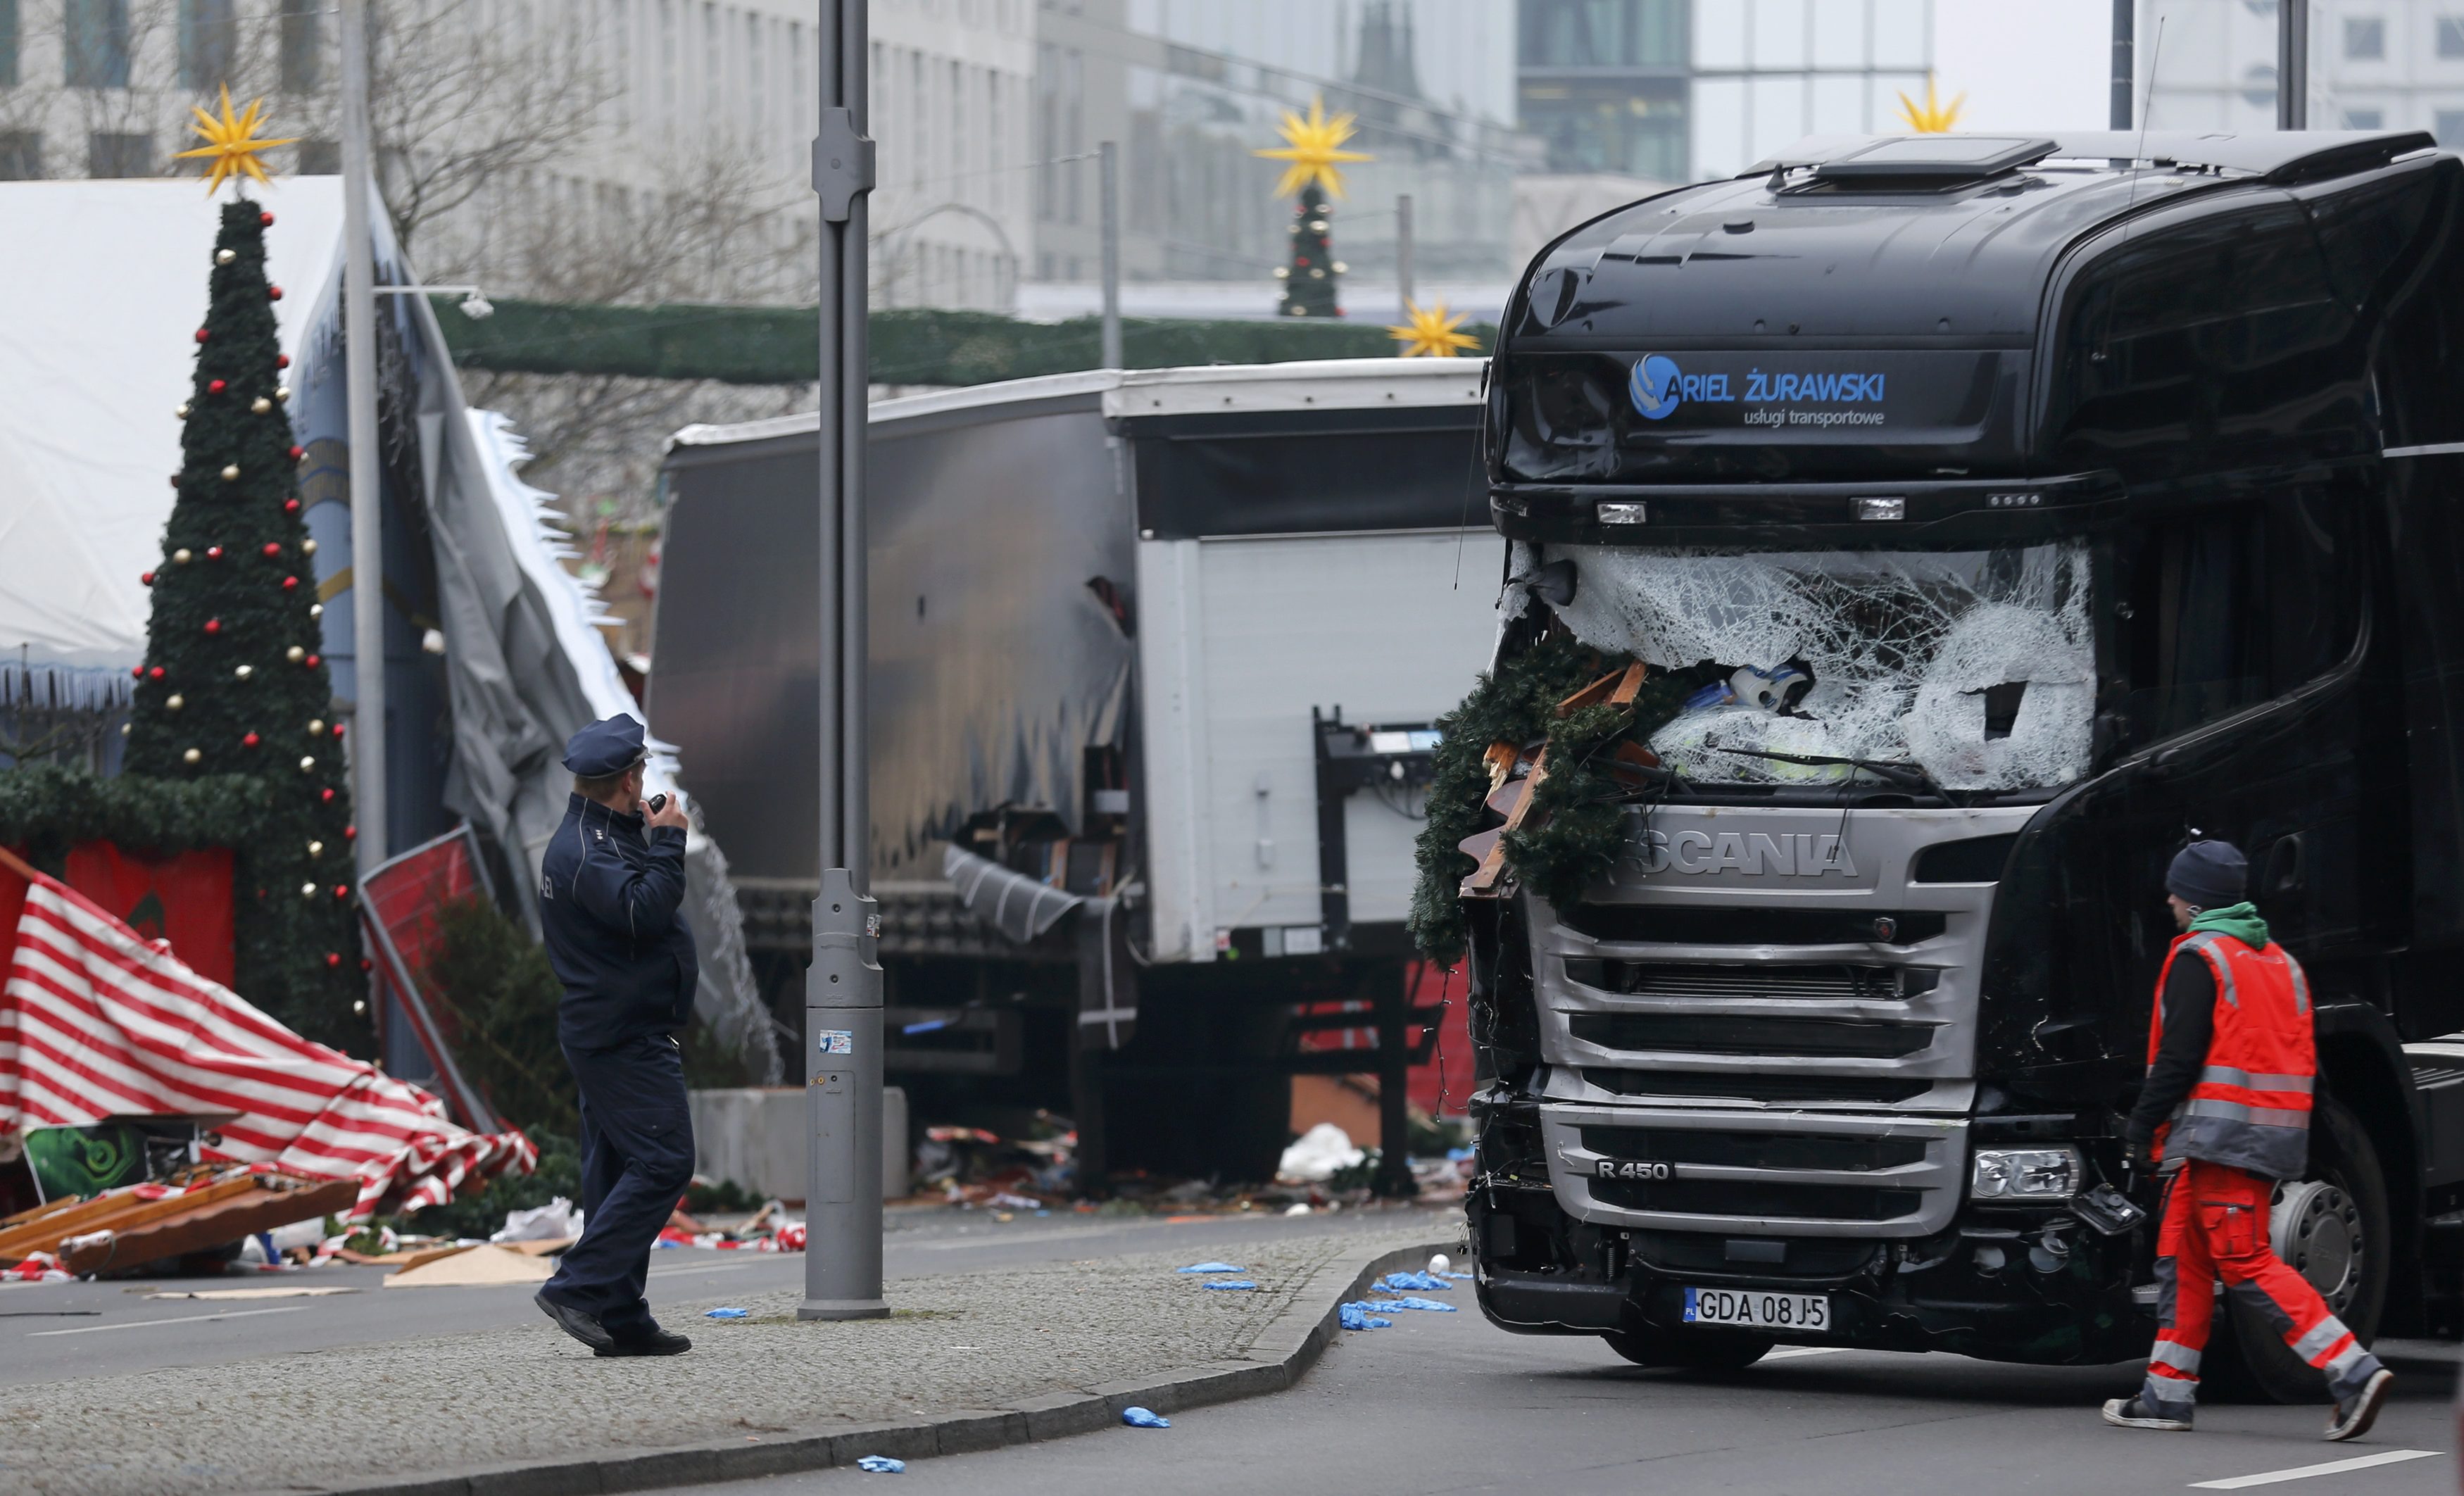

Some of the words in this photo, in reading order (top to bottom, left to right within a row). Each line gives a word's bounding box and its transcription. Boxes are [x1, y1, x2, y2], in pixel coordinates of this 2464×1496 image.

[1662, 372, 1735, 402] ARIEL
[1744, 367, 1886, 402] ŻURAWSKI
[1744, 408, 1785, 428] usługi
[1789, 410, 1885, 427] transportowe
[1632, 829, 1859, 877] SCANIA
[1598, 1162, 1616, 1178] R
[1619, 1162, 1669, 1180] 450
[1685, 1307, 1695, 1316] PL
[1701, 1292, 1753, 1322] GDA
